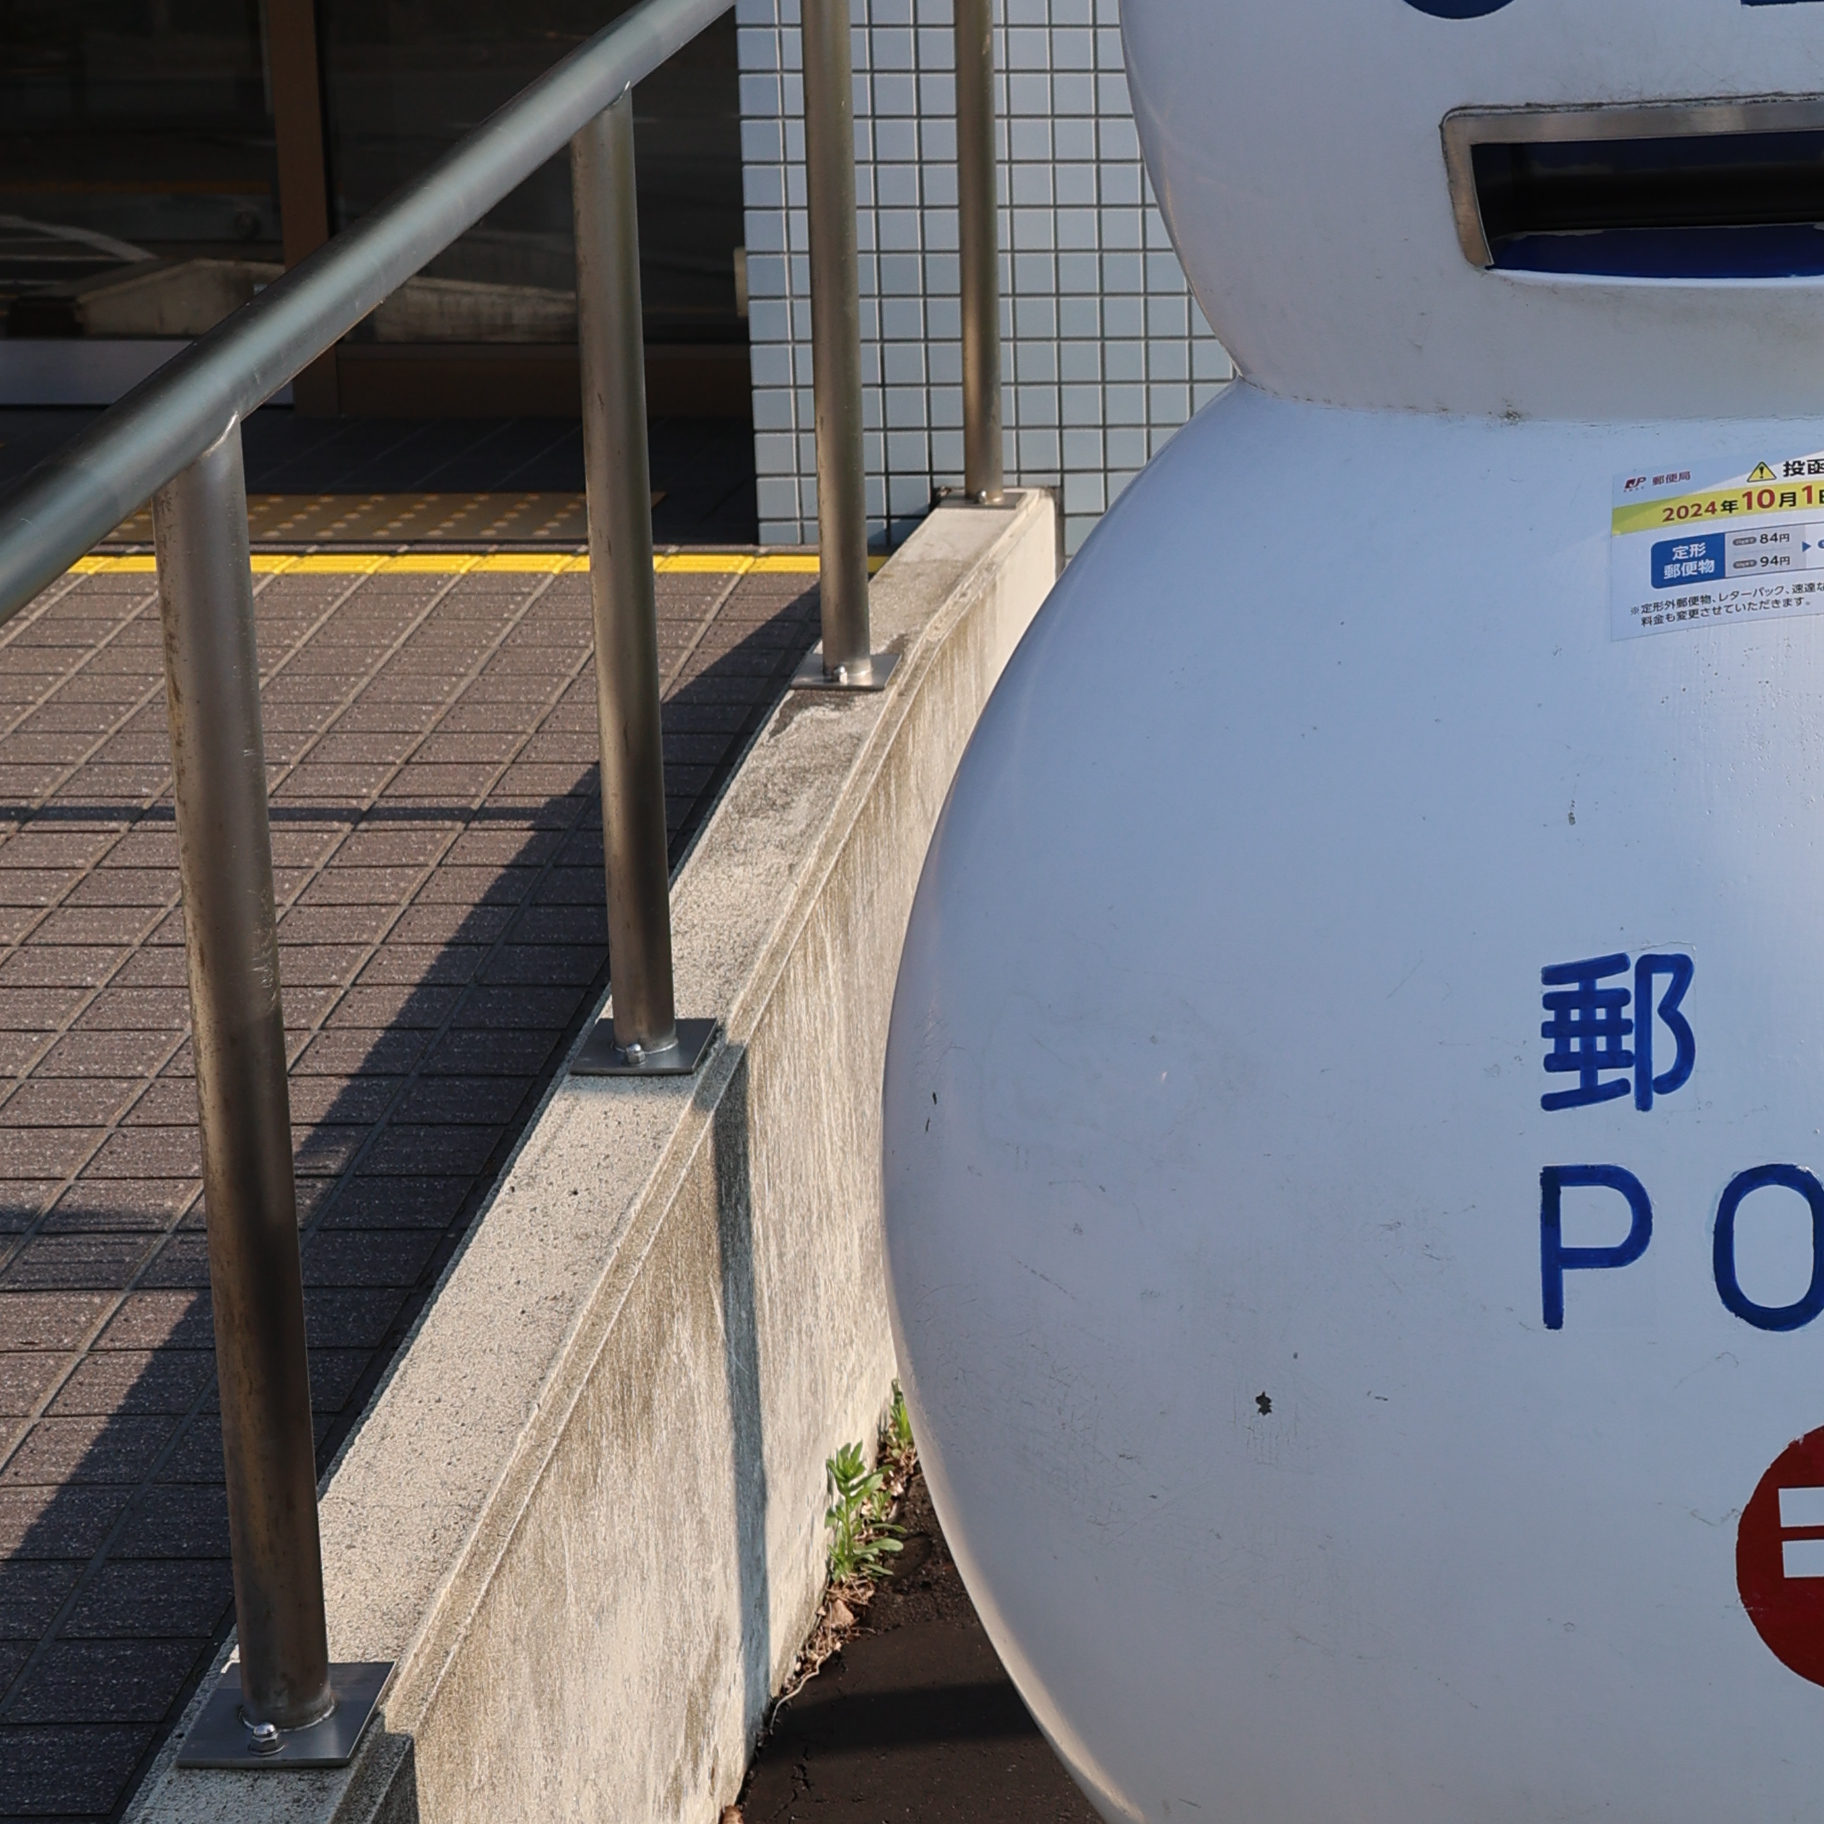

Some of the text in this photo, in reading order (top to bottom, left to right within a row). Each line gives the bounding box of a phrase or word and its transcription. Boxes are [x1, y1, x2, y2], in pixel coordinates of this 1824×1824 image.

[1652, 471, 1691, 486] 郵便局
[1760, 533, 1790, 545] 84円
[1672, 542, 1706, 560] 定形
[1663, 558, 1715, 579] 郵便物
[1760, 555, 1790, 568] 94円
